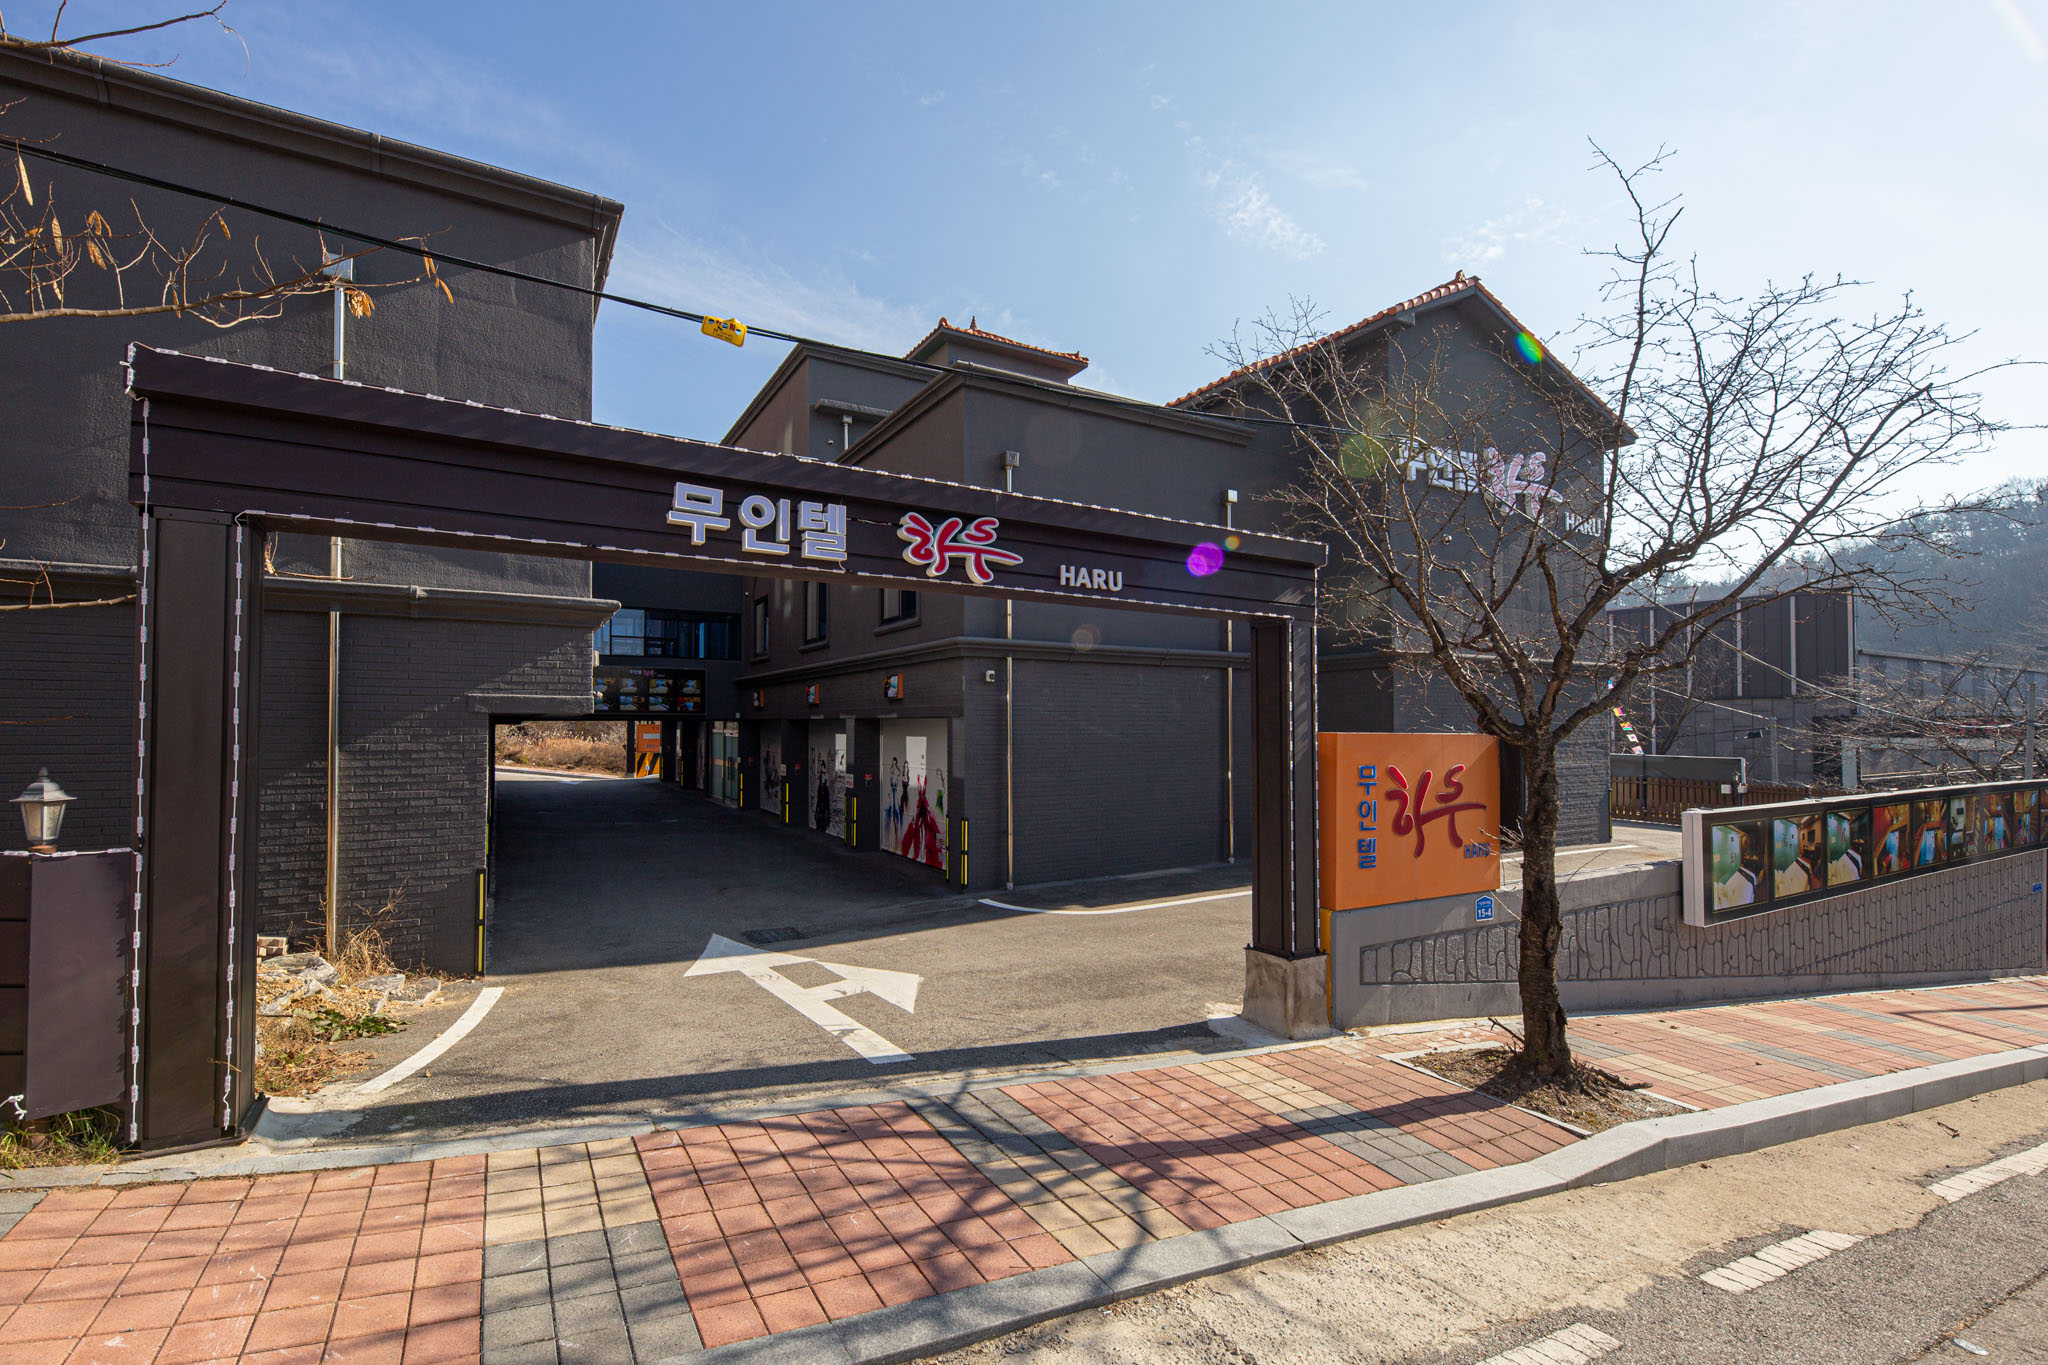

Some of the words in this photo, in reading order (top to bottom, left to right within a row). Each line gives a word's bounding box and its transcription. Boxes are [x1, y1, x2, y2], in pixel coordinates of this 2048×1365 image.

[666, 481, 848, 561] 무인텔
[1059, 564, 1123, 592] HARU
[1357, 765, 1377, 869] 무인텔
[1464, 842, 1490, 859] HARU
[1477, 908, 1492, 918] 15-4
